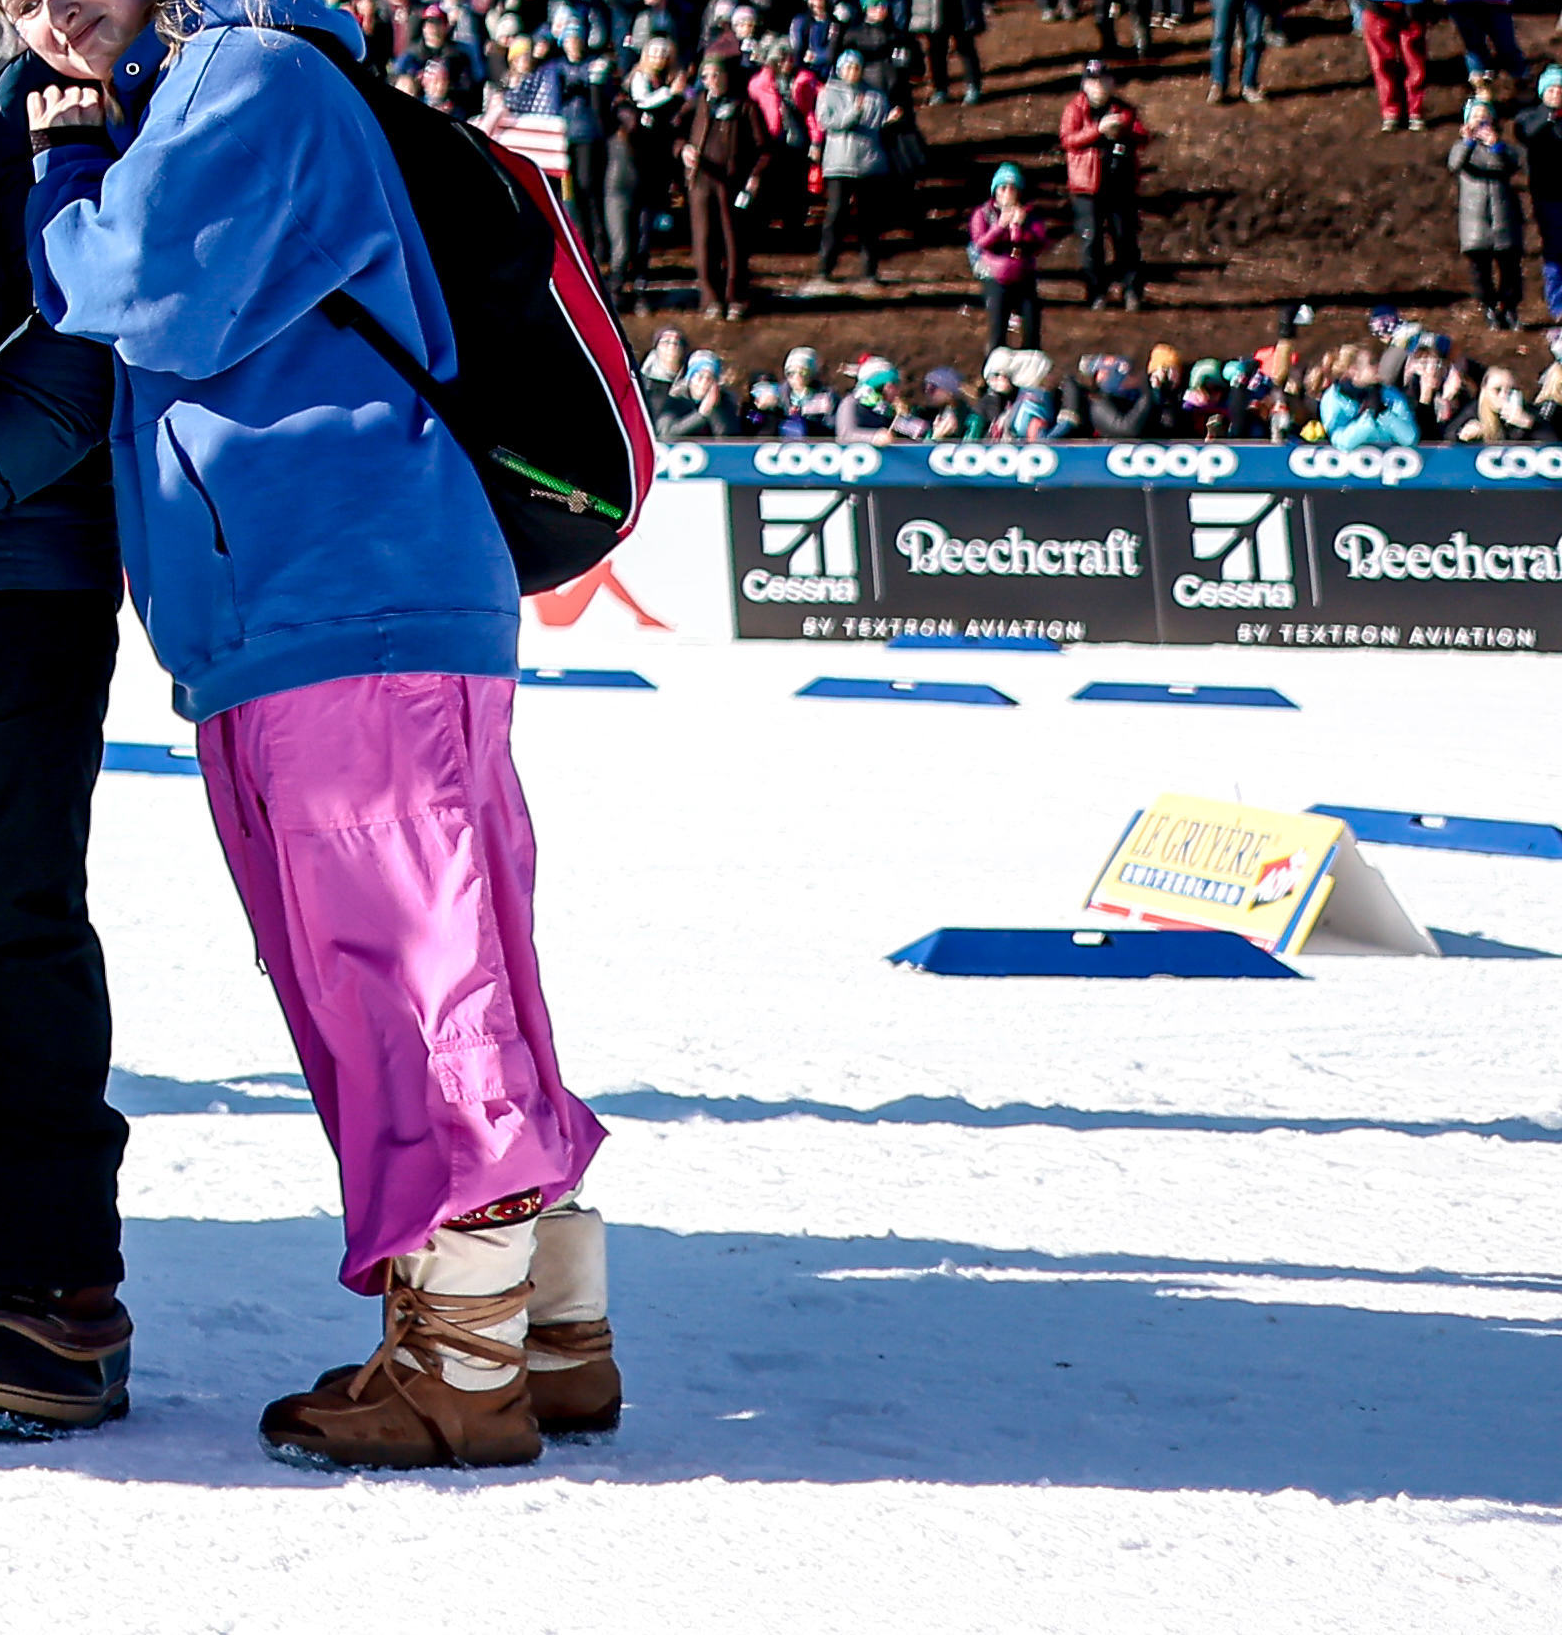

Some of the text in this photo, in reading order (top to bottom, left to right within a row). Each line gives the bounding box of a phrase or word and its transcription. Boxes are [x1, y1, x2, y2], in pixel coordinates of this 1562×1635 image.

[754, 442, 881, 483] coop
[929, 443, 1058, 482] coop
[1107, 443, 1239, 483] coop
[1289, 446, 1422, 485] coop
[896, 520, 1143, 580] Beechcraft
[1334, 525, 1562, 584] Beechcra
[742, 569, 859, 605] Cessna
[1173, 573, 1295, 609] Cessna
[802, 616, 1086, 642] BY TEXTRON AVIATION
[1237, 623, 1537, 647] BY TEXTRON AVIATION
[1131, 811, 1159, 859] LE
[1120, 862, 1245, 907] SWITZERLAND
